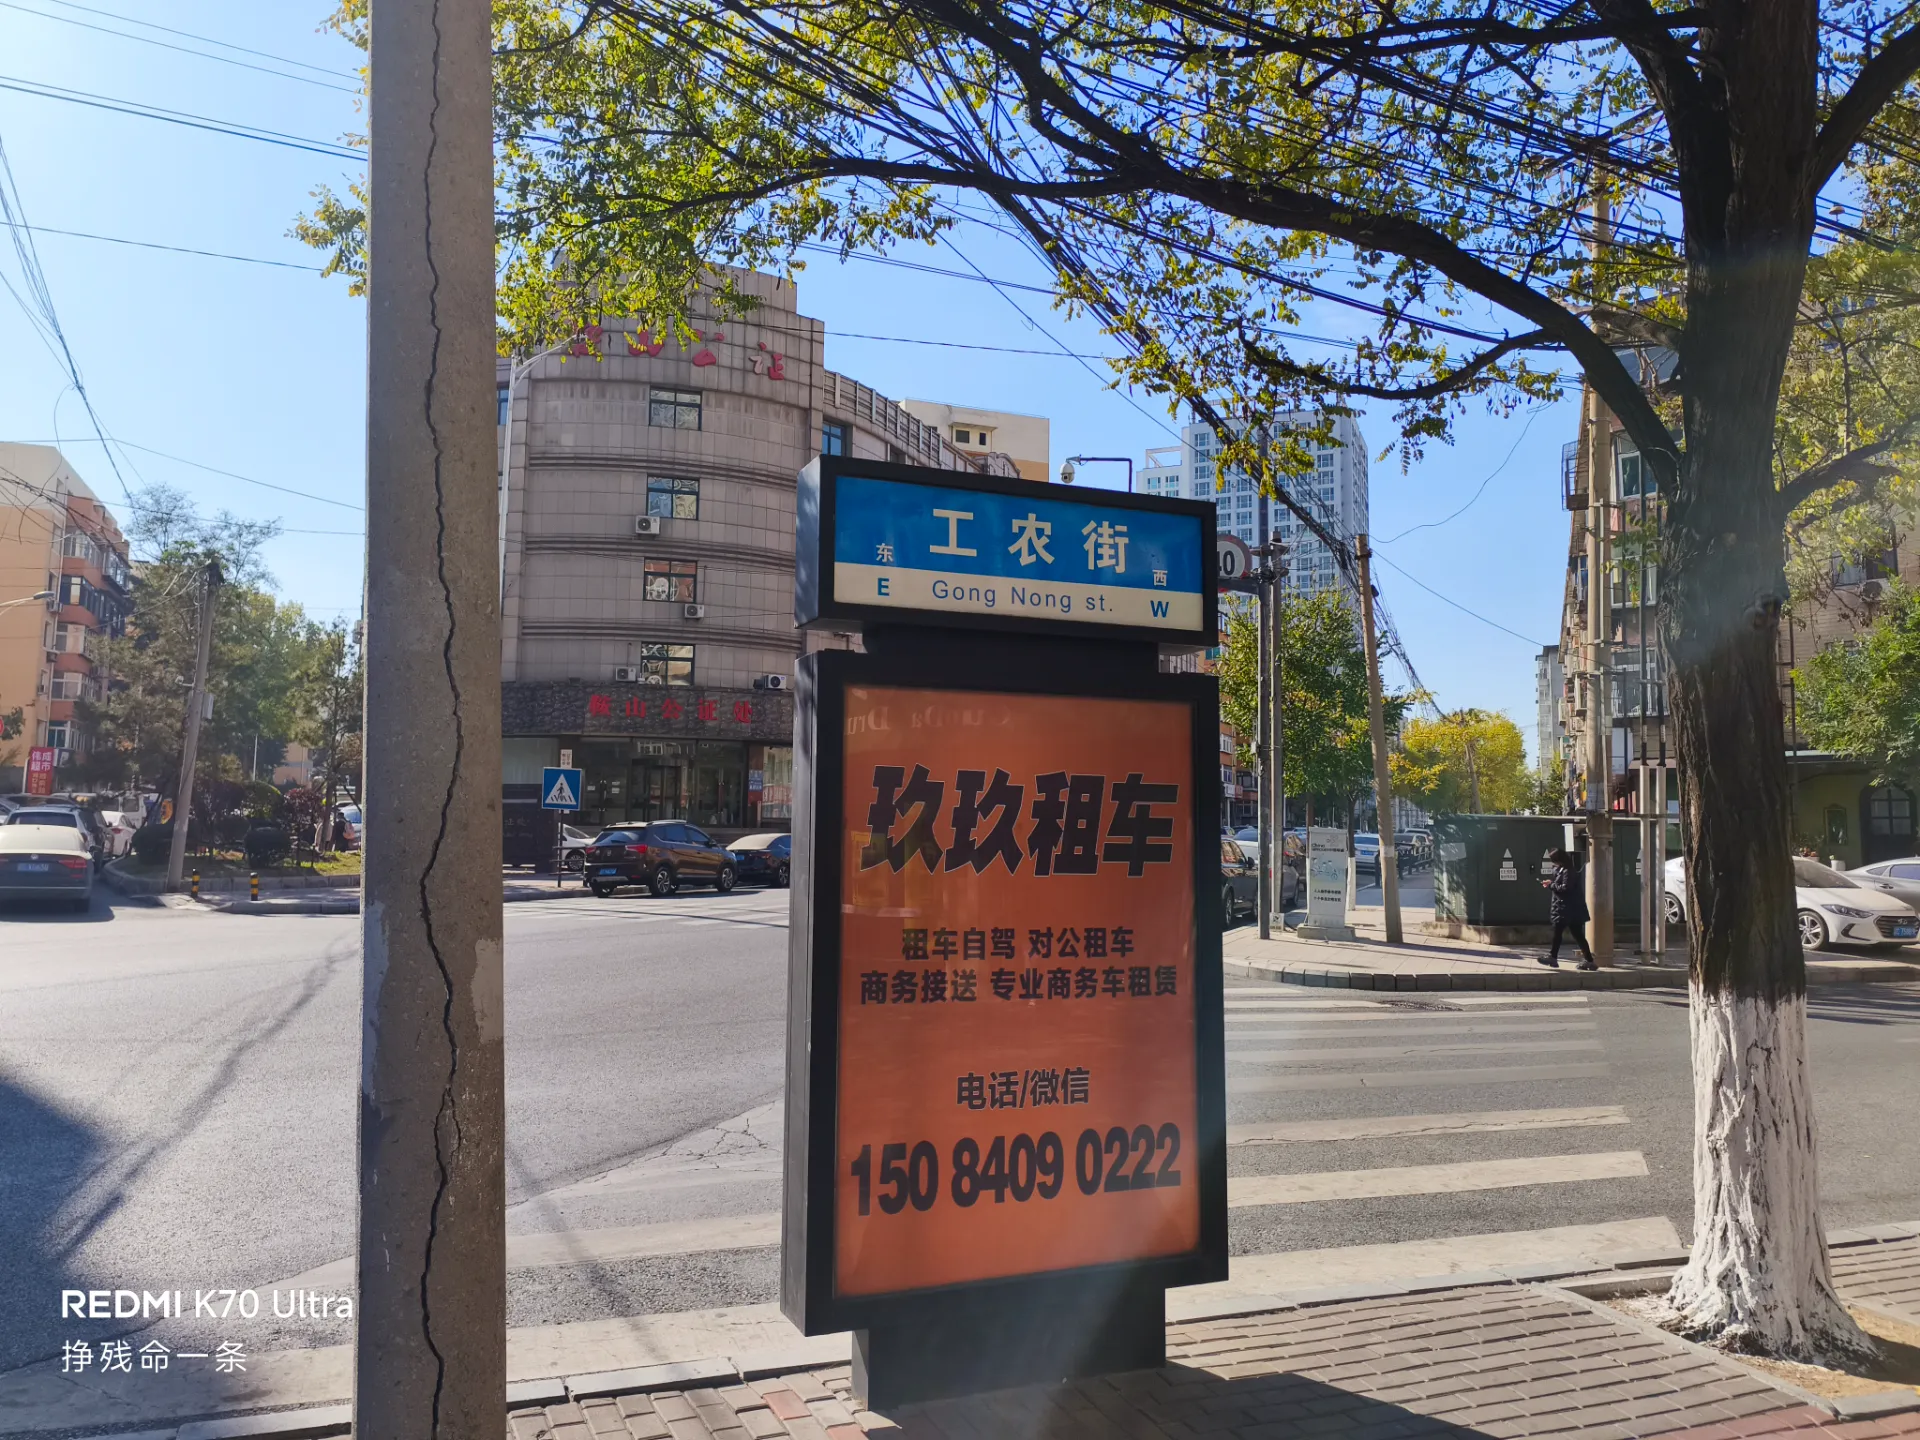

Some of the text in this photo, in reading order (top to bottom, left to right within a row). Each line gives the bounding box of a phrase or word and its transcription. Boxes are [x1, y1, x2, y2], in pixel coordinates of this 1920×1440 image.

[875, 542, 894, 564] 东
[929, 508, 1130, 574] 工农街
[876, 577, 890, 597] E
[1152, 568, 1169, 588] 西
[931, 579, 1114, 614] Gong Nong st.
[1150, 600, 1170, 619] W
[588, 693, 753, 724] 鞍山公证处
[859, 762, 1180, 878] 玖玖租车
[901, 926, 1135, 961] 租车自驾 对公租车
[860, 964, 1178, 1005] 商务接送 专业商务车租赁
[955, 1066, 1090, 1111] 电话/微信
[850, 1122, 1182, 1217] 150 8409 0222
